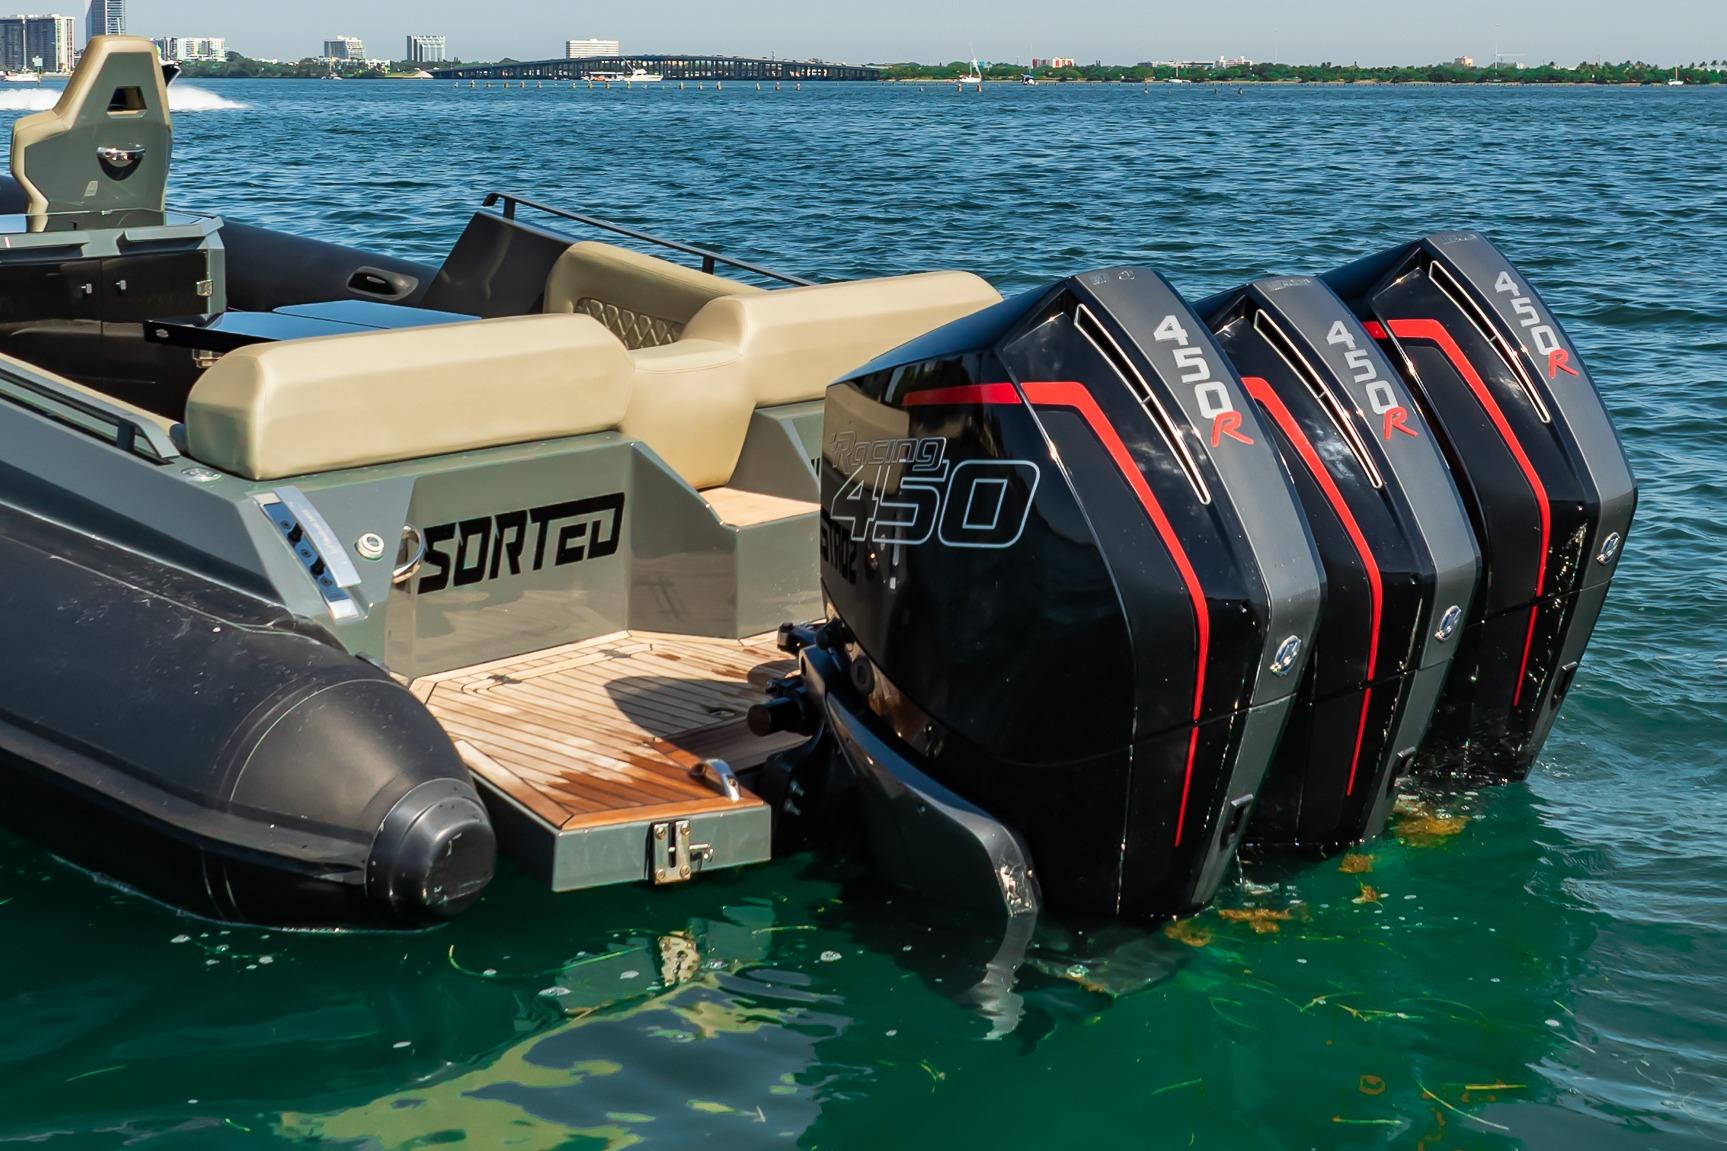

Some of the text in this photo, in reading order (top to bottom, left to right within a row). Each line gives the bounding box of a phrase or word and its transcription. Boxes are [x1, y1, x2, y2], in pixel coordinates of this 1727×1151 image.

[1494, 271, 1580, 379] 450R
[1153, 314, 1255, 448] 450R
[1326, 320, 1419, 441] 450R
[830, 459, 1040, 548] 450
[831, 431, 946, 474] Racing
[417, 491, 625, 595] SORTED
